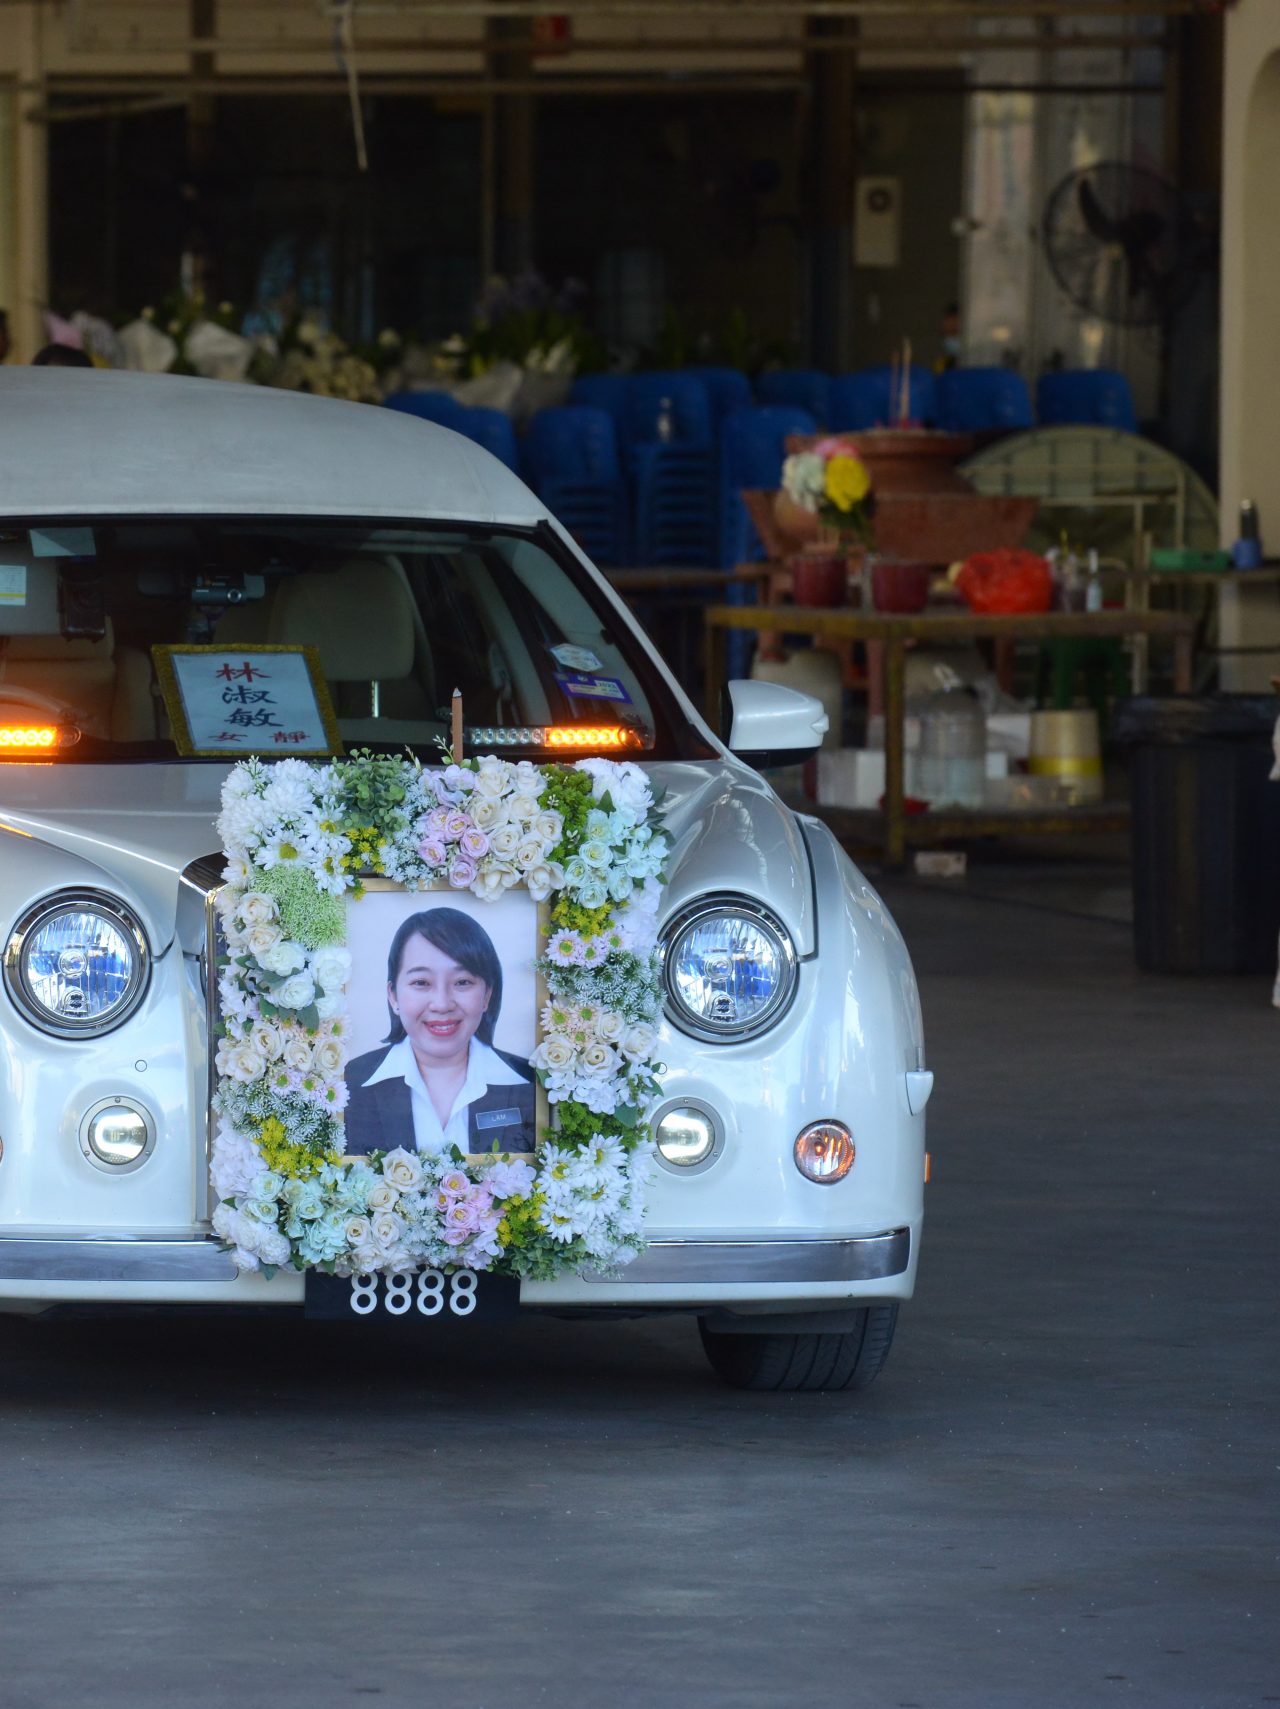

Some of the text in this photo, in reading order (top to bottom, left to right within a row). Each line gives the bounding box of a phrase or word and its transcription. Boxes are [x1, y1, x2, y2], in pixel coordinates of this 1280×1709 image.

[216, 661, 284, 727] 林淑敏
[350, 1268, 478, 1316] 8888
